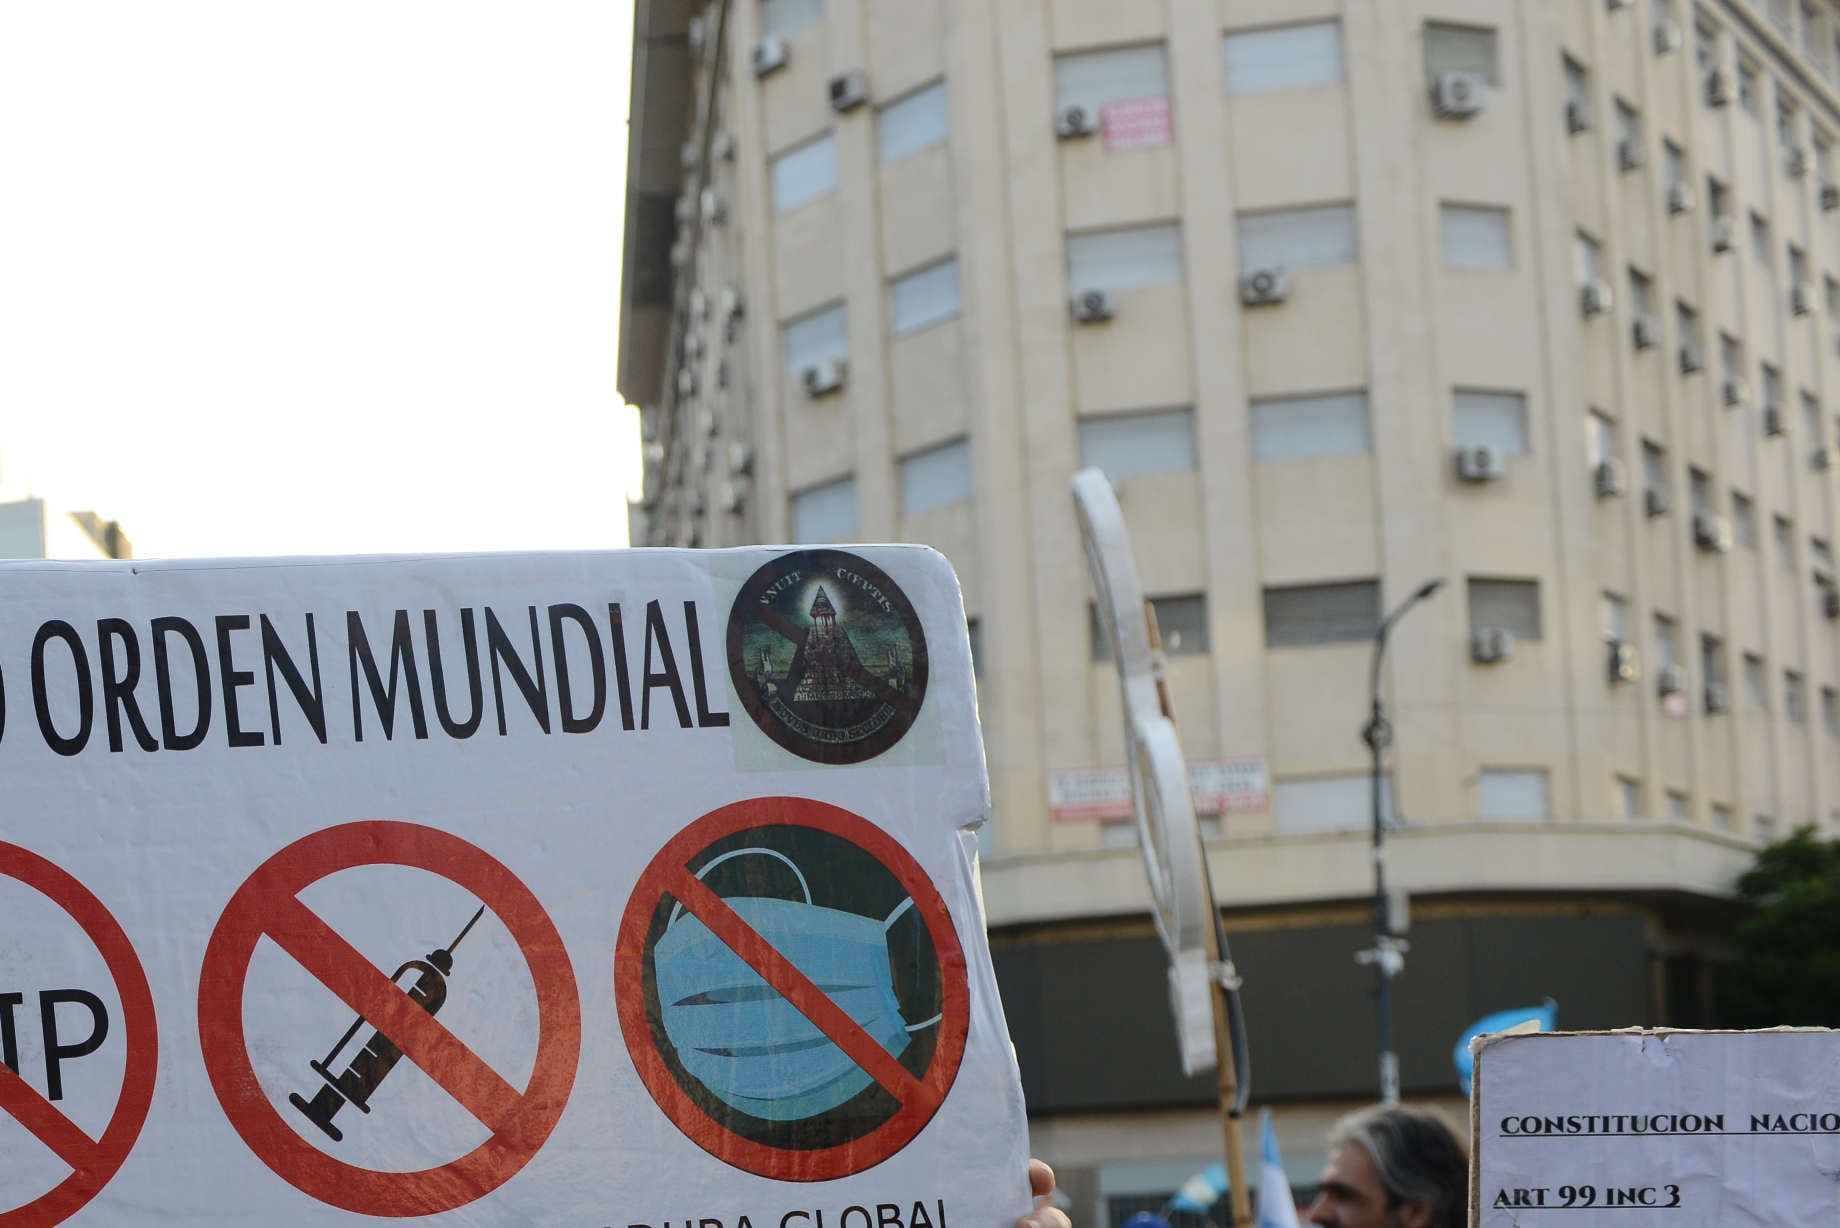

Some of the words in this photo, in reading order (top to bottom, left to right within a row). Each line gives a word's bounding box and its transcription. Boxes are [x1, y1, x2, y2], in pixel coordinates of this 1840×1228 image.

[31, 613, 327, 756] ORDEN
[347, 600, 731, 741] MUNDIAL
[1500, 1114, 1724, 1133] CONSTITUCION
[1494, 1187, 1549, 1206] ART
[1558, 1185, 1596, 1208] 99
[1606, 1187, 1656, 1206] INC
[1664, 1184, 1681, 1207] 3
